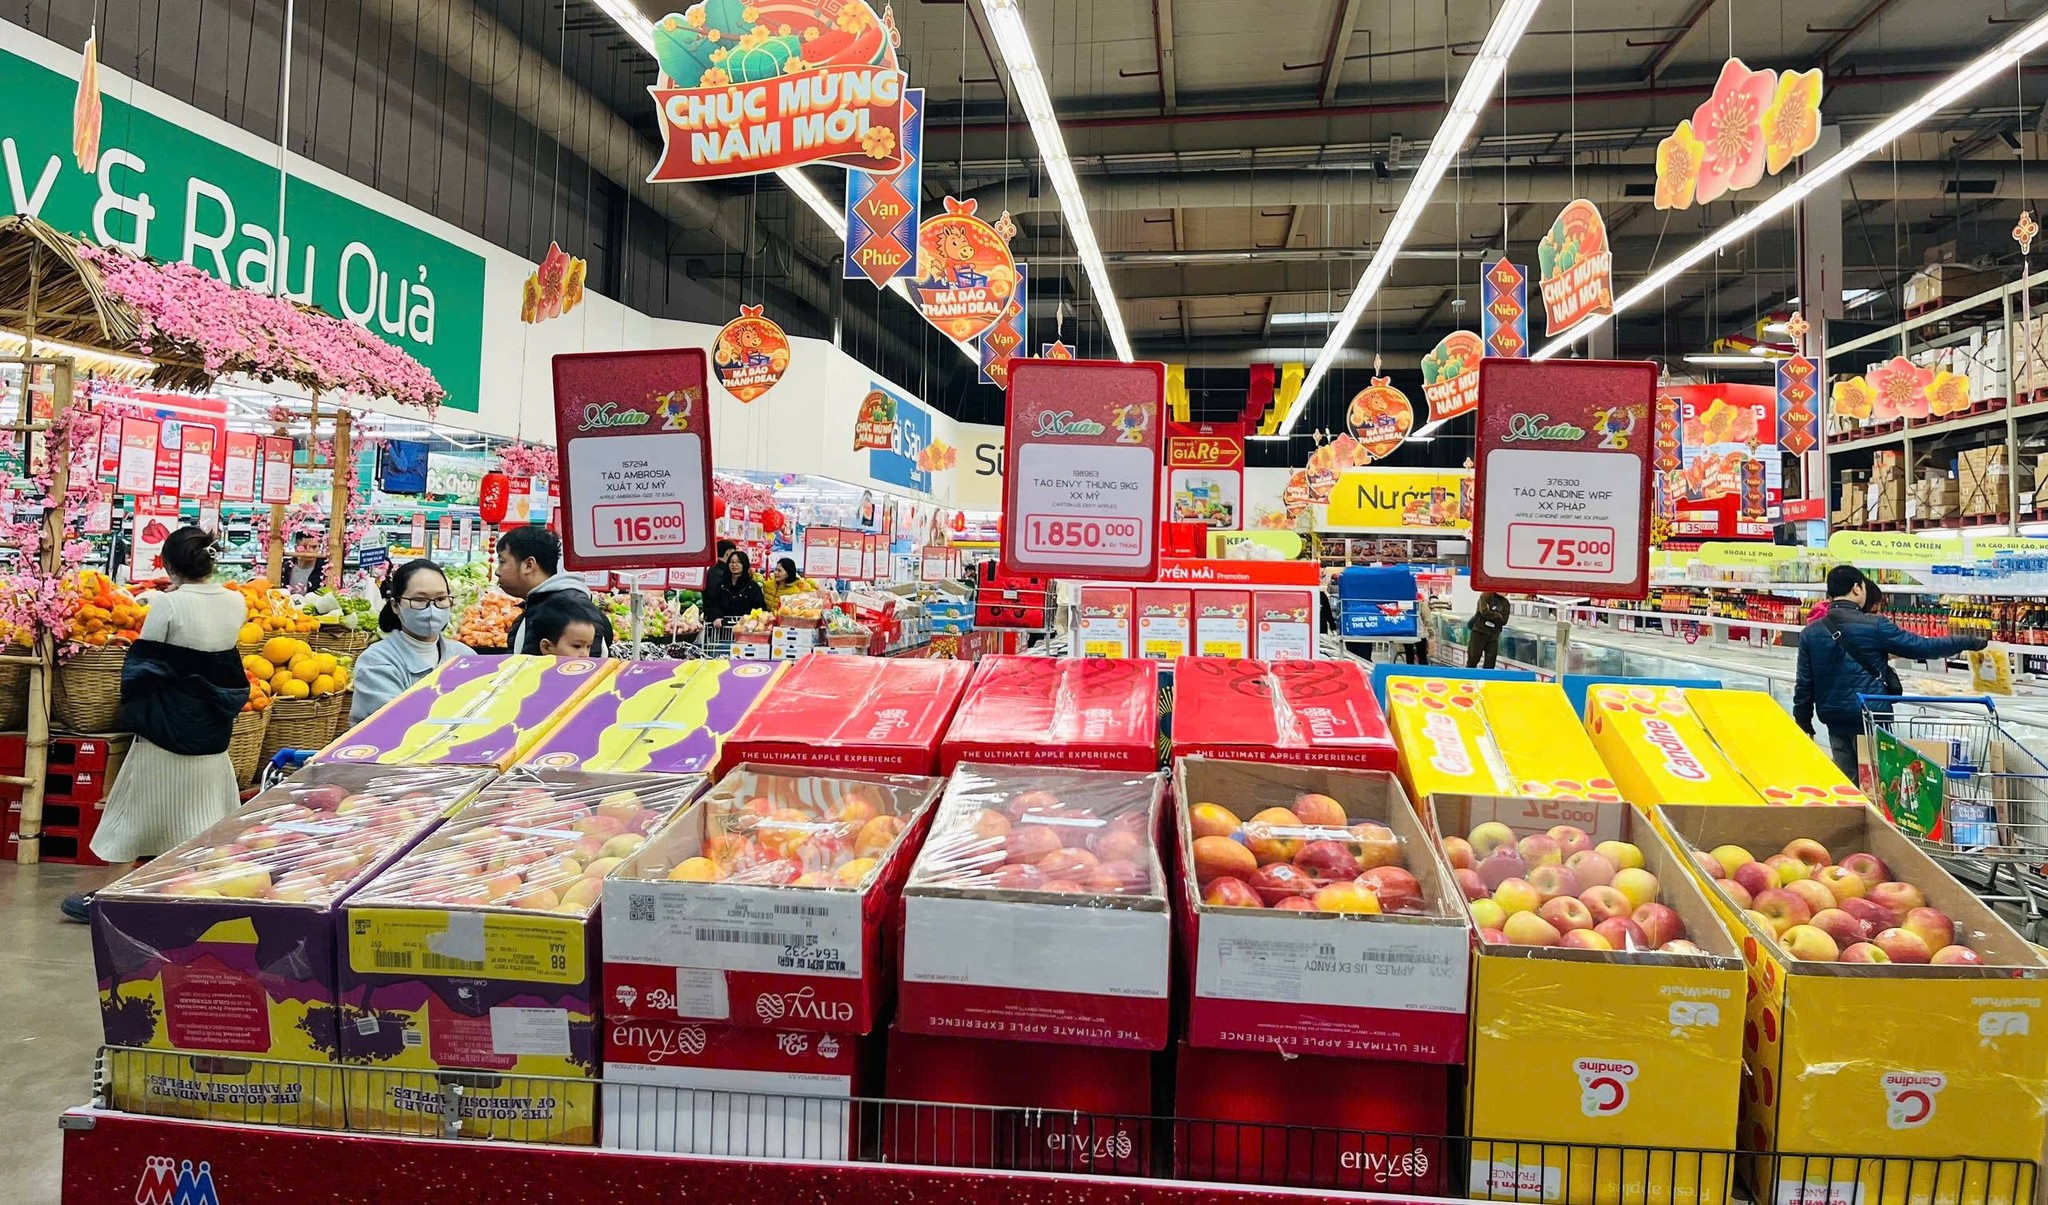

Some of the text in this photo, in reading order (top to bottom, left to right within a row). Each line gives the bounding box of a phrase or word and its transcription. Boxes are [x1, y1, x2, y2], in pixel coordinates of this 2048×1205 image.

[666, 68, 900, 132] CHÚC MỪNG
[690, 104, 871, 166] NĂM MỚI
[868, 199, 899, 221] Vạn
[183, 177, 314, 305] Rau
[339, 241, 435, 345] Quả
[862, 247, 901, 267] Phúc
[1496, 270, 1514, 284] Tân
[967, 301, 1001, 315] DEAL
[1494, 302, 1518, 316] Niên
[993, 333, 1014, 347] Vạn
[1497, 334, 1516, 349] Vạn
[1789, 363, 1808, 377] Vạn
[1791, 388, 1806, 399] Sự
[578, 402, 650, 431] Xuân
[1031, 410, 1105, 437] Xuân
[1787, 411, 1809, 422] Như
[1501, 413, 1585, 443] Xuân
[622, 460, 648, 469] 157294
[601, 469, 671, 480] TÁO AMBROSIA
[1033, 477, 1053, 488] TÁO
[1055, 479, 1082, 489] ENVY
[1120, 481, 1138, 491] 9KG
[1546, 478, 1580, 487] 376300
[1069, 491, 1083, 500] XX
[1513, 486, 1613, 500] TÁO CANDINE WRF
[1538, 500, 1587, 511] XX PHÁP
[1890, 540, 1911, 548] TÔM
[1191, 565, 1214, 579] MÃI
[741, 751, 903, 763] THE ULTIMATE APPLE EXPERIENCE
[962, 750, 1129, 760] THE ULTIMATE APPLE EXPERIENCE
[1195, 750, 1367, 762] THE ULTIMATE APPLE EXPERIENCE
[1645, 719, 1706, 781] Candine
[548, 942, 567, 953] AAA
[783, 945, 839, 959] E64-232
[551, 954, 567, 970] 88
[777, 956, 795, 968] AGRI
[1304, 959, 1415, 977] APPLES US EX FANCY
[783, 986, 854, 1022] envy
[928, 1016, 1141, 1040] THE ULTIMATE APPLE EXPERIENCE
[612, 1025, 679, 1063] envy
[1219, 1030, 1437, 1054] THE ULTIMATE APPLE EXPERIENCE
[1579, 1060, 1634, 1076] Candine
[207, 1081, 302, 1093] AMBROSIA OF
[1886, 1075, 1941, 1088] Candine
[152, 1085, 300, 1105] STANDARD GOLD THE
[534, 1096, 556, 1108] OF
[479, 1108, 553, 1120] GOLD THE
[1047, 1131, 1104, 1163] envy
[1340, 1150, 1403, 1183] envy
